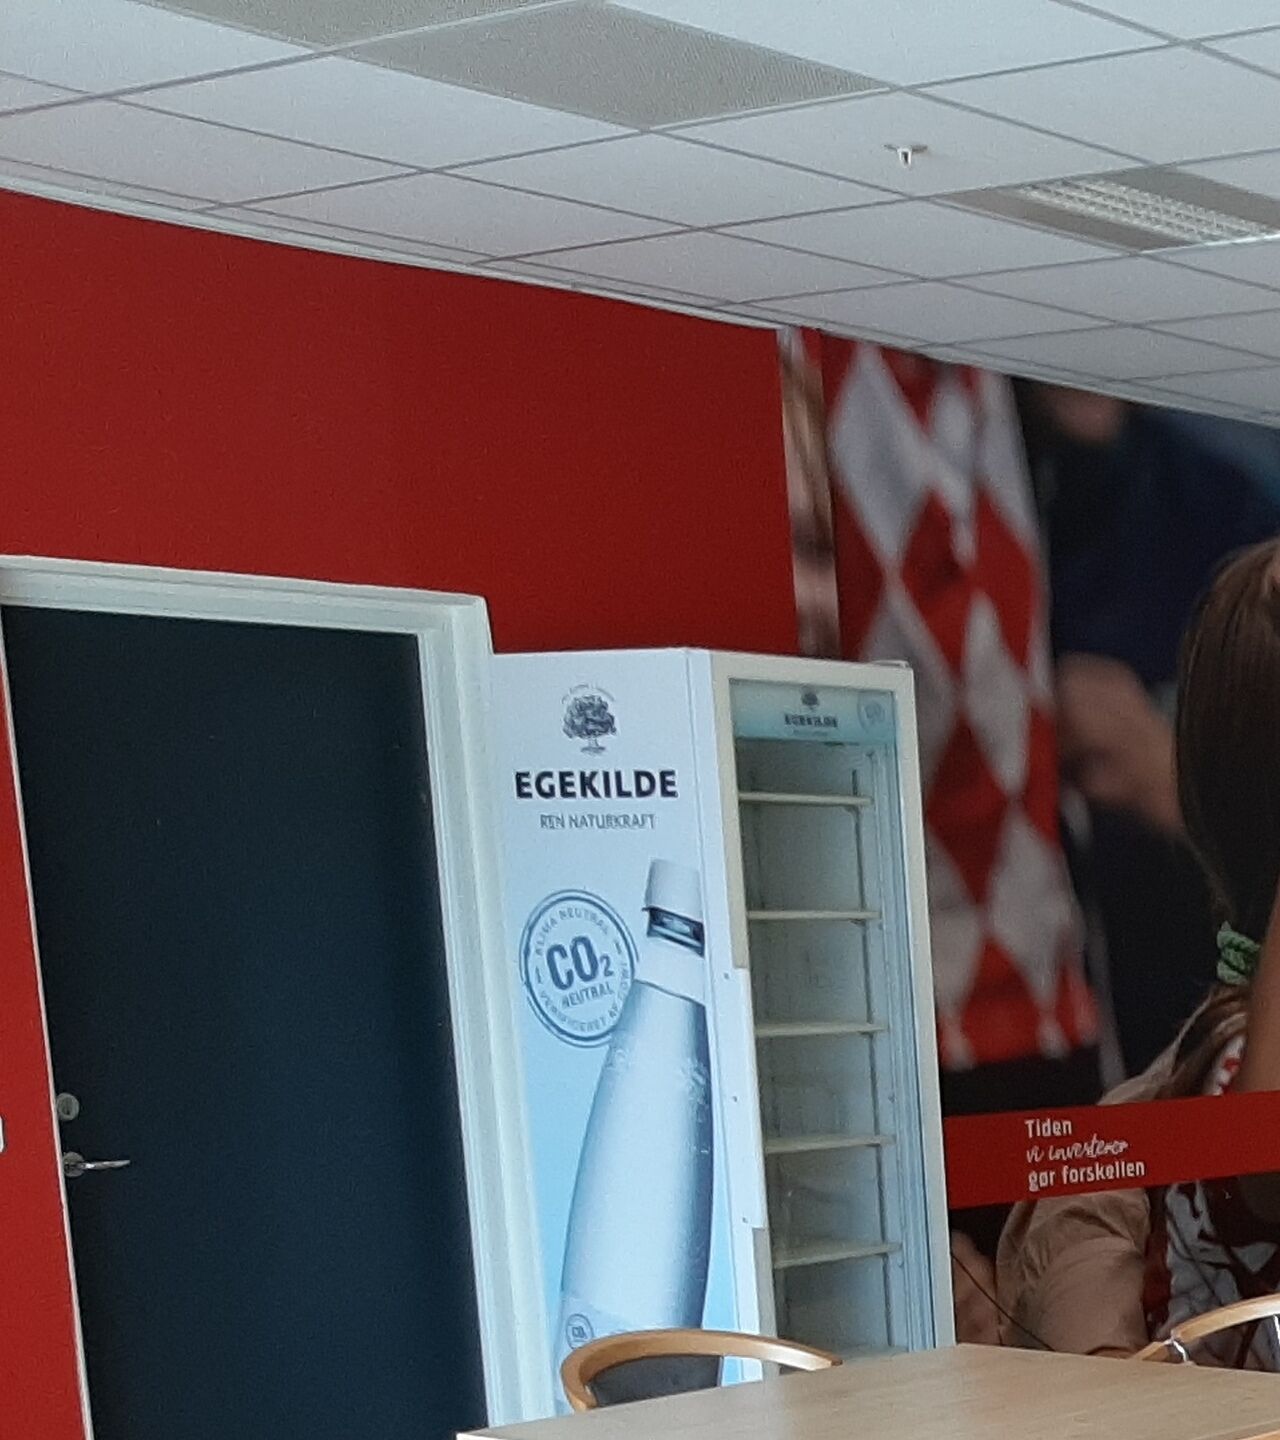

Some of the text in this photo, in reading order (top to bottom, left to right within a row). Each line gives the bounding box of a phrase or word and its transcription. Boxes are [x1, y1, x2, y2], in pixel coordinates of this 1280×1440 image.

[514, 770, 679, 799] EGEKILDE
[540, 814, 656, 829] REN NATURKRAFT
[561, 982, 616, 1009] NEUTRAL
[1024, 1118, 1072, 1139] Tiden
[1026, 1145, 1045, 1163] vi
[1028, 1160, 1145, 1192] gør forskellen
